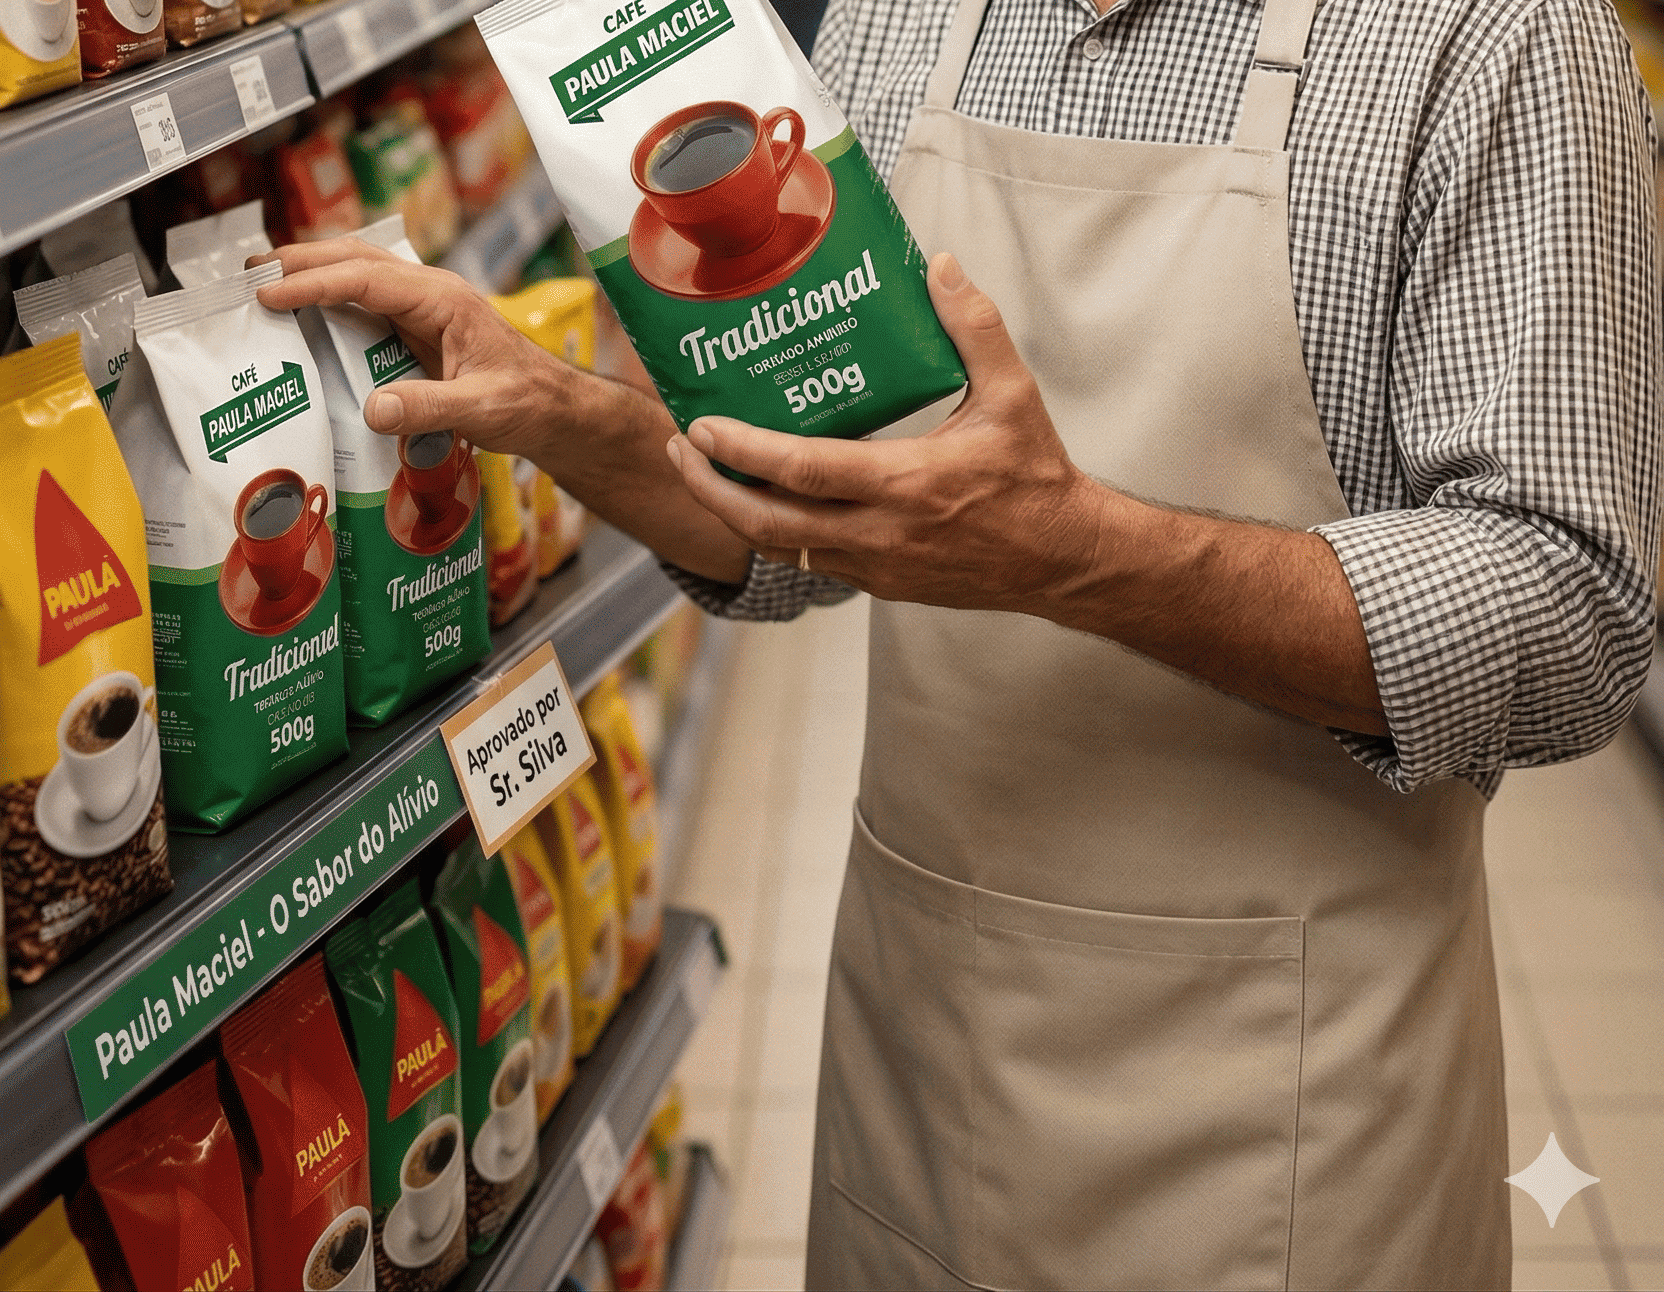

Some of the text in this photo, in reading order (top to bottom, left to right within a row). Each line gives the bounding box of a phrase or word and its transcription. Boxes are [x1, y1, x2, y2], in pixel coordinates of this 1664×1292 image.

[564, 45, 638, 103] PAULA
[679, 249, 881, 376] Tradicional
[231, 363, 258, 392] CAFÉ
[372, 342, 411, 374] PAULA
[208, 377, 304, 443] PAULA MACIEL
[784, 362, 866, 414] 500g
[425, 624, 461, 658] 500g
[270, 714, 315, 754] 500g
[467, 686, 561, 776] Aprovado por
[489, 731, 568, 807] Sr. Silva
[95, 997, 173, 1080] Paula
[172, 918, 255, 1017] Maciel
[269, 894, 290, 935] O
[291, 845, 354, 918] Sabor
[357, 821, 385, 865] do
[387, 775, 440, 842] Alívio
